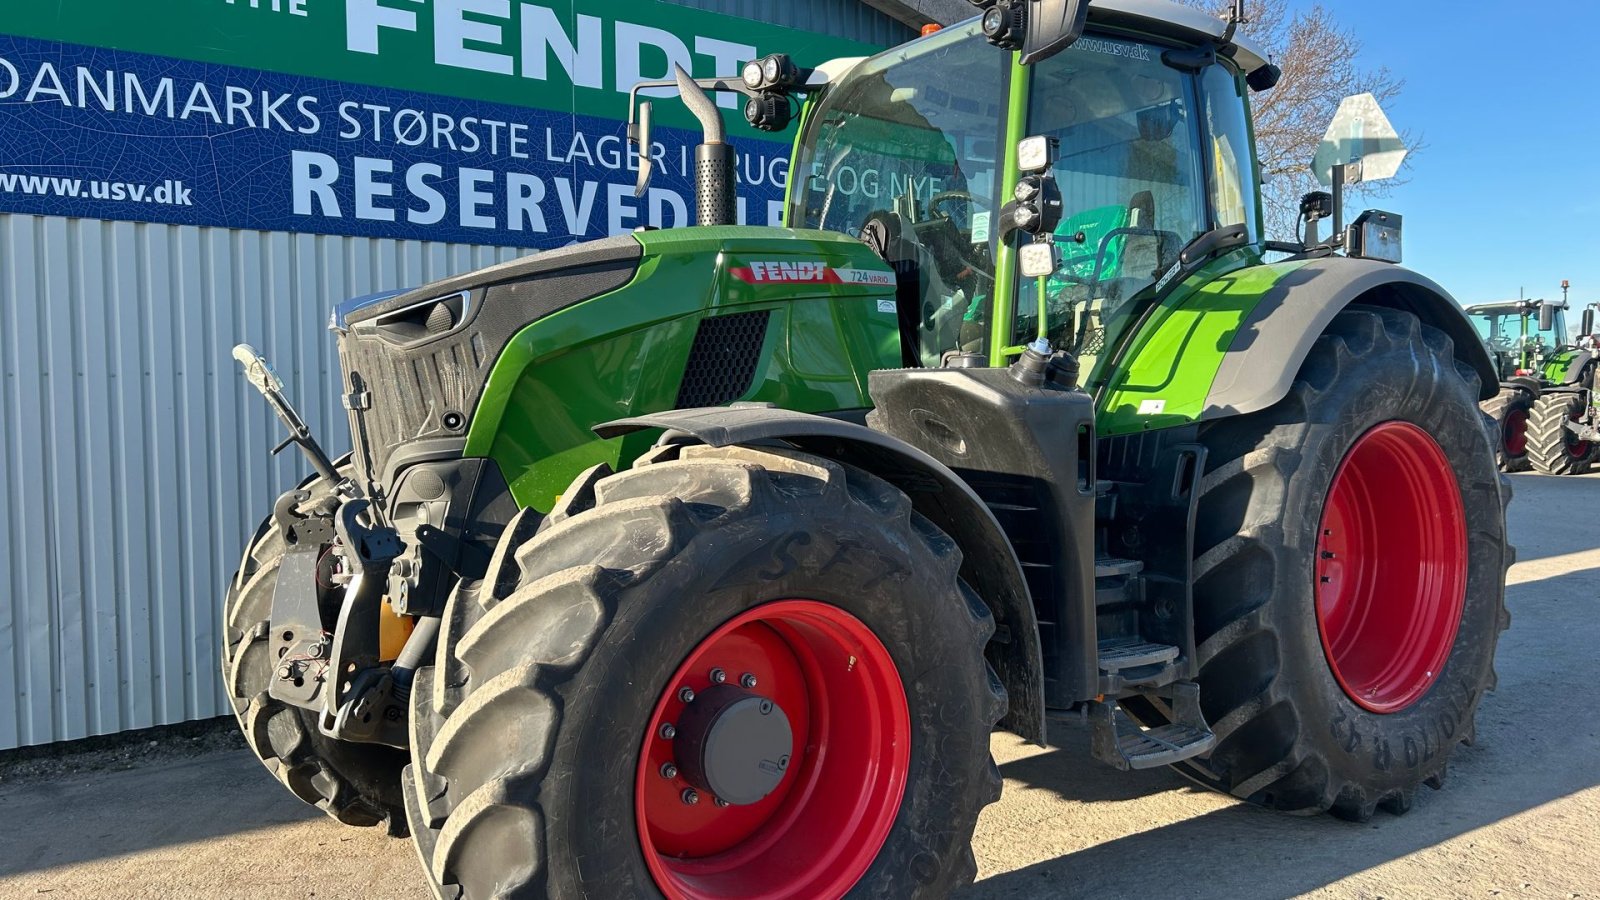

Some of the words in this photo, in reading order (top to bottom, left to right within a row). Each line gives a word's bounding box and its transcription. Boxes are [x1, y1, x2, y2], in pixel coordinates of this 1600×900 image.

[346, 0, 757, 110] FENDT
[1068, 38, 1150, 61] ww.usv.dk
[339, 100, 529, 158] STØRSTE
[546, 131, 668, 176] LAGER
[837, 165, 879, 199] OG
[0, 173, 193, 206] www.usv.dk
[749, 261, 827, 281] FENDT
[850, 270, 869, 283] 724
[868, 274, 889, 284] VARIO
